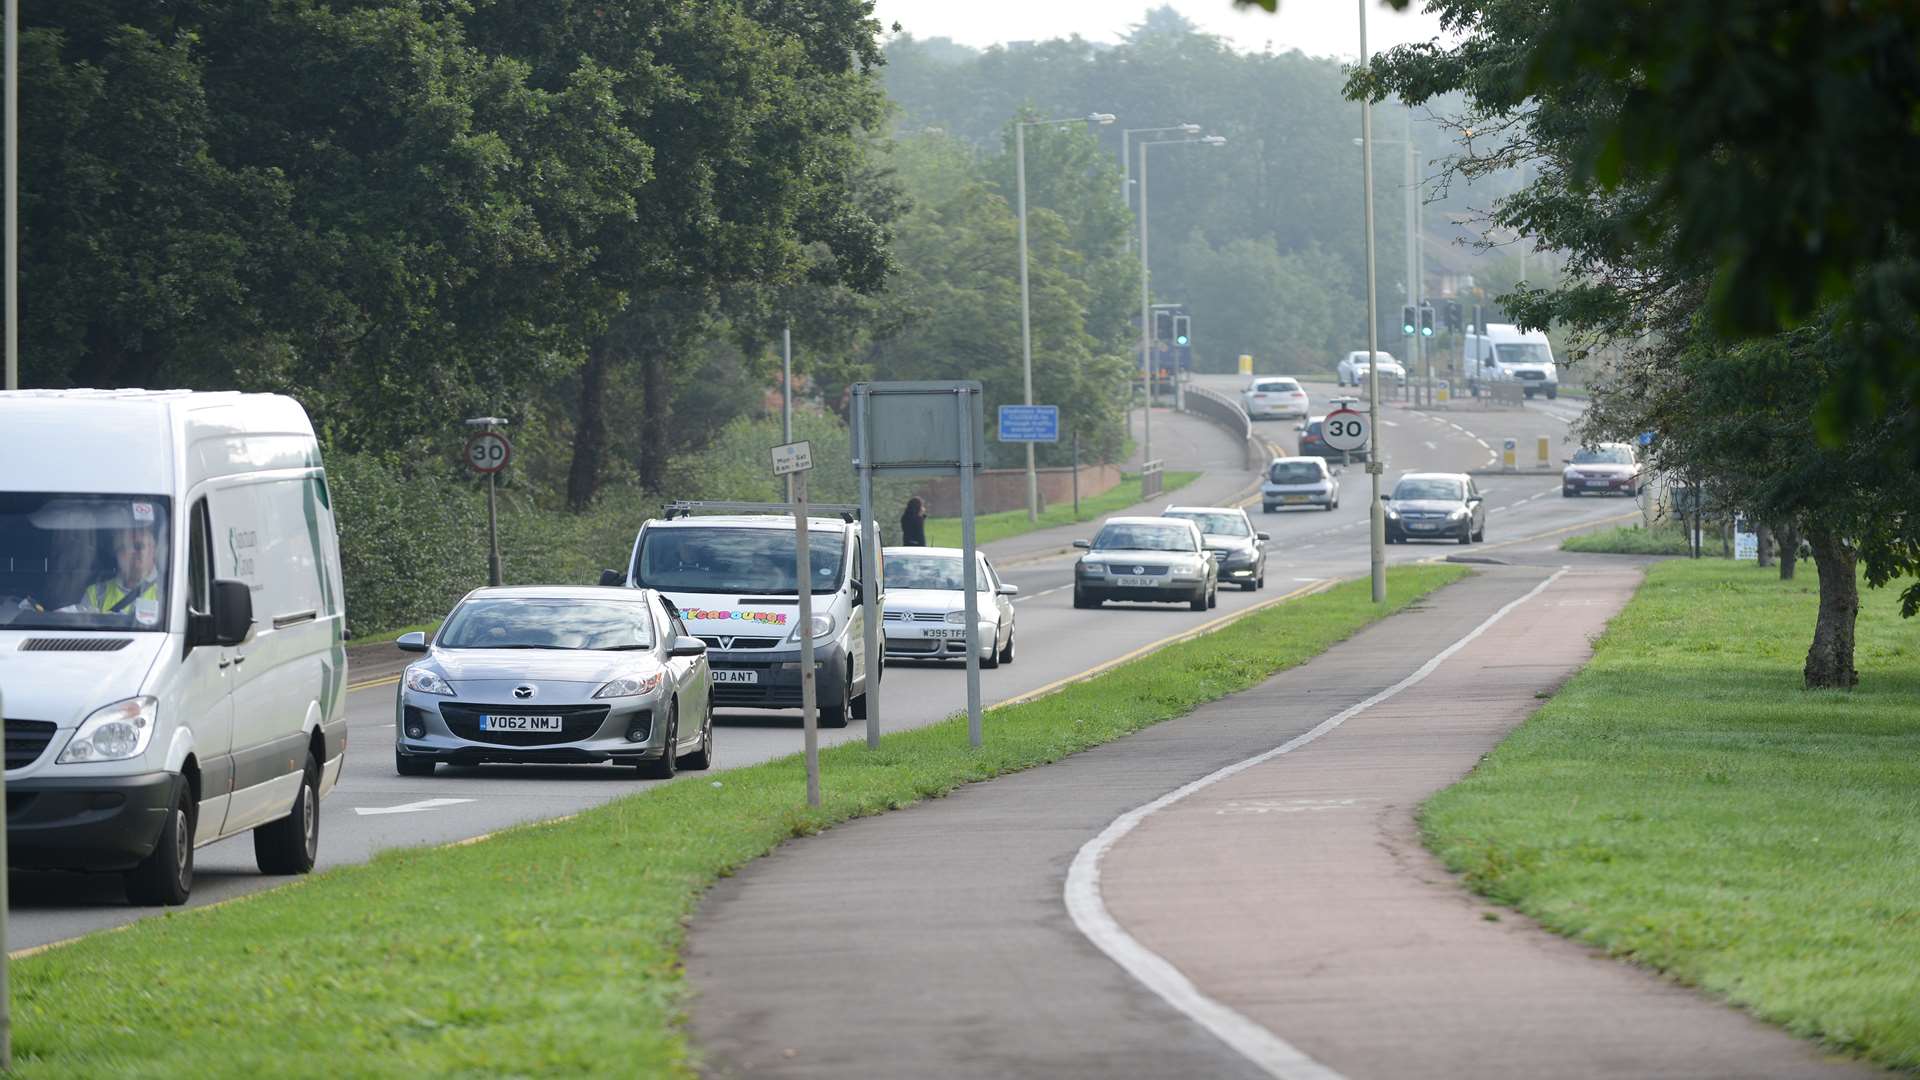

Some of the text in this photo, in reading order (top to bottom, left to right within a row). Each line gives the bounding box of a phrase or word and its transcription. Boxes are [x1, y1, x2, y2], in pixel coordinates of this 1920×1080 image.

[1329, 420, 1362, 437] 30
[473, 445, 503, 460] 30
[730, 671, 753, 681] ANT
[530, 717, 559, 729] NMJ
